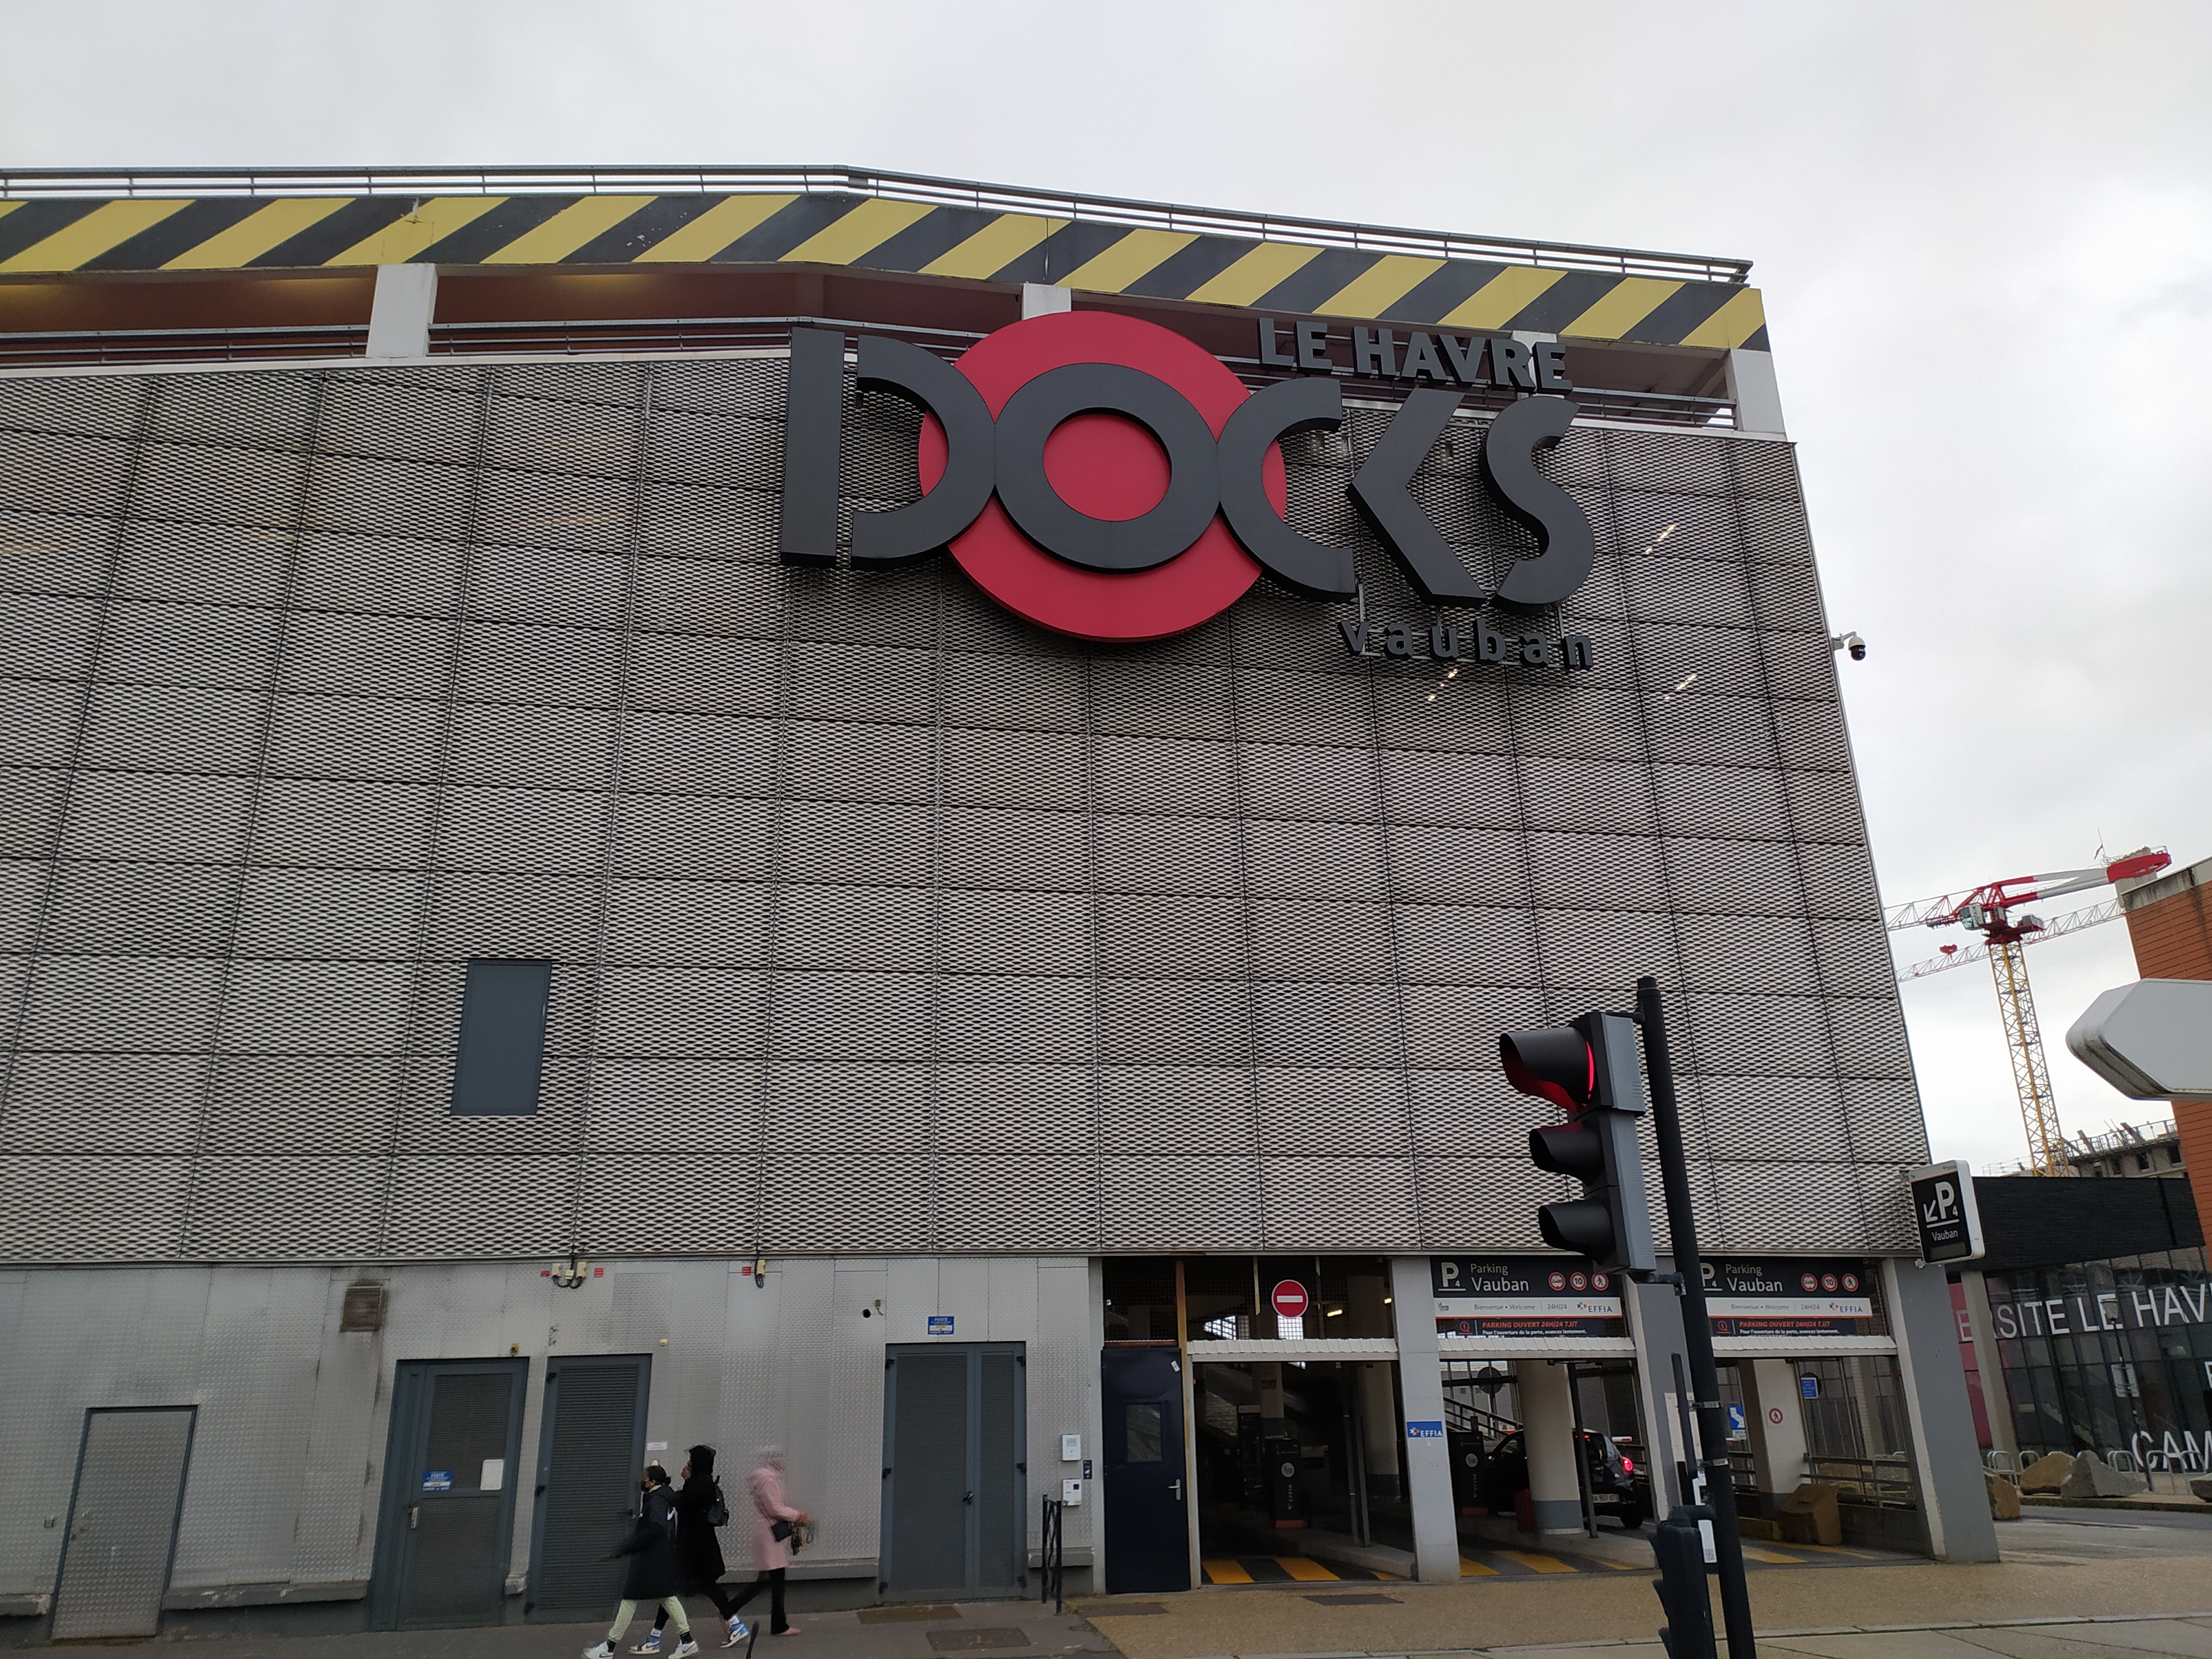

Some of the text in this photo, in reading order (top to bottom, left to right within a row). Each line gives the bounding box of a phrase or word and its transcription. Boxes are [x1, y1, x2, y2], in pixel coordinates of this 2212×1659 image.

[1258, 317, 1573, 394] LE HAVRE
[781, 326, 1594, 615] DOCKS
[1338, 617, 1593, 670] vauban
[1932, 1229, 1959, 1241] Vauban
[1470, 1263, 1509, 1276] Parking
[1725, 1264, 1762, 1276] Parking
[1470, 1277, 1530, 1291] Vauban
[1726, 1277, 1783, 1292] Vauban
[2077, 1293, 2123, 1332] LE
[2131, 1282, 2212, 1328] HAV
